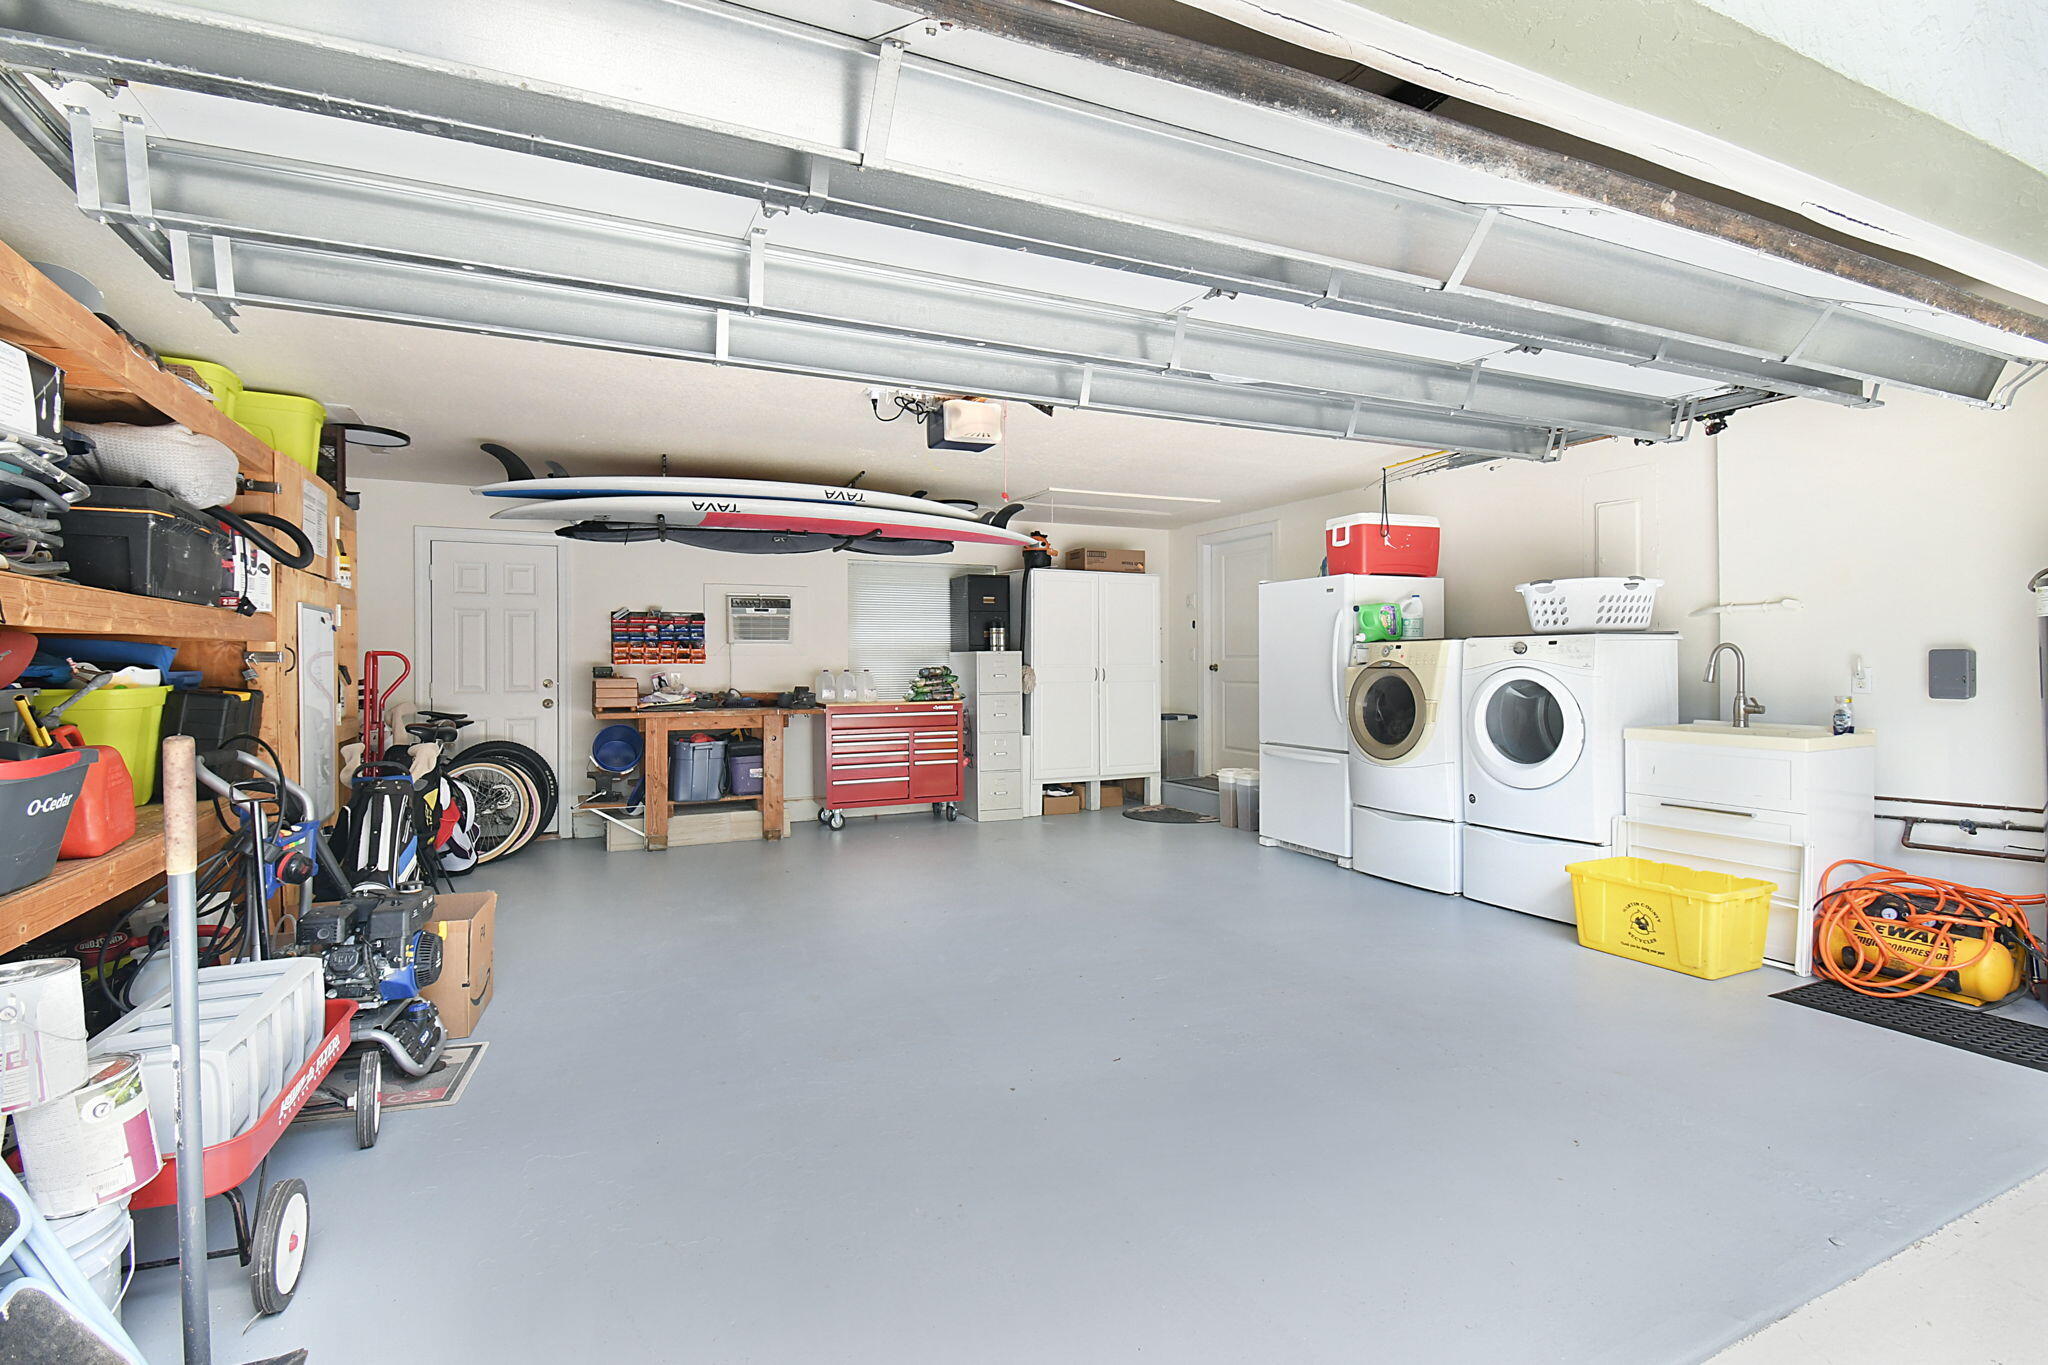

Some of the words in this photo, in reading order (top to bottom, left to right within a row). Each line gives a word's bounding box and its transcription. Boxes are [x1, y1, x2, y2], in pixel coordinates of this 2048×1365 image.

[824, 489, 866, 503] TAVA
[692, 500, 741, 514] TAVA
[27, 792, 74, 817] O-Cedar
[1640, 902, 1661, 923] COUNTY
[79, 933, 124, 951] KINSFORD
[1887, 942, 1950, 962] OMPRESOR
